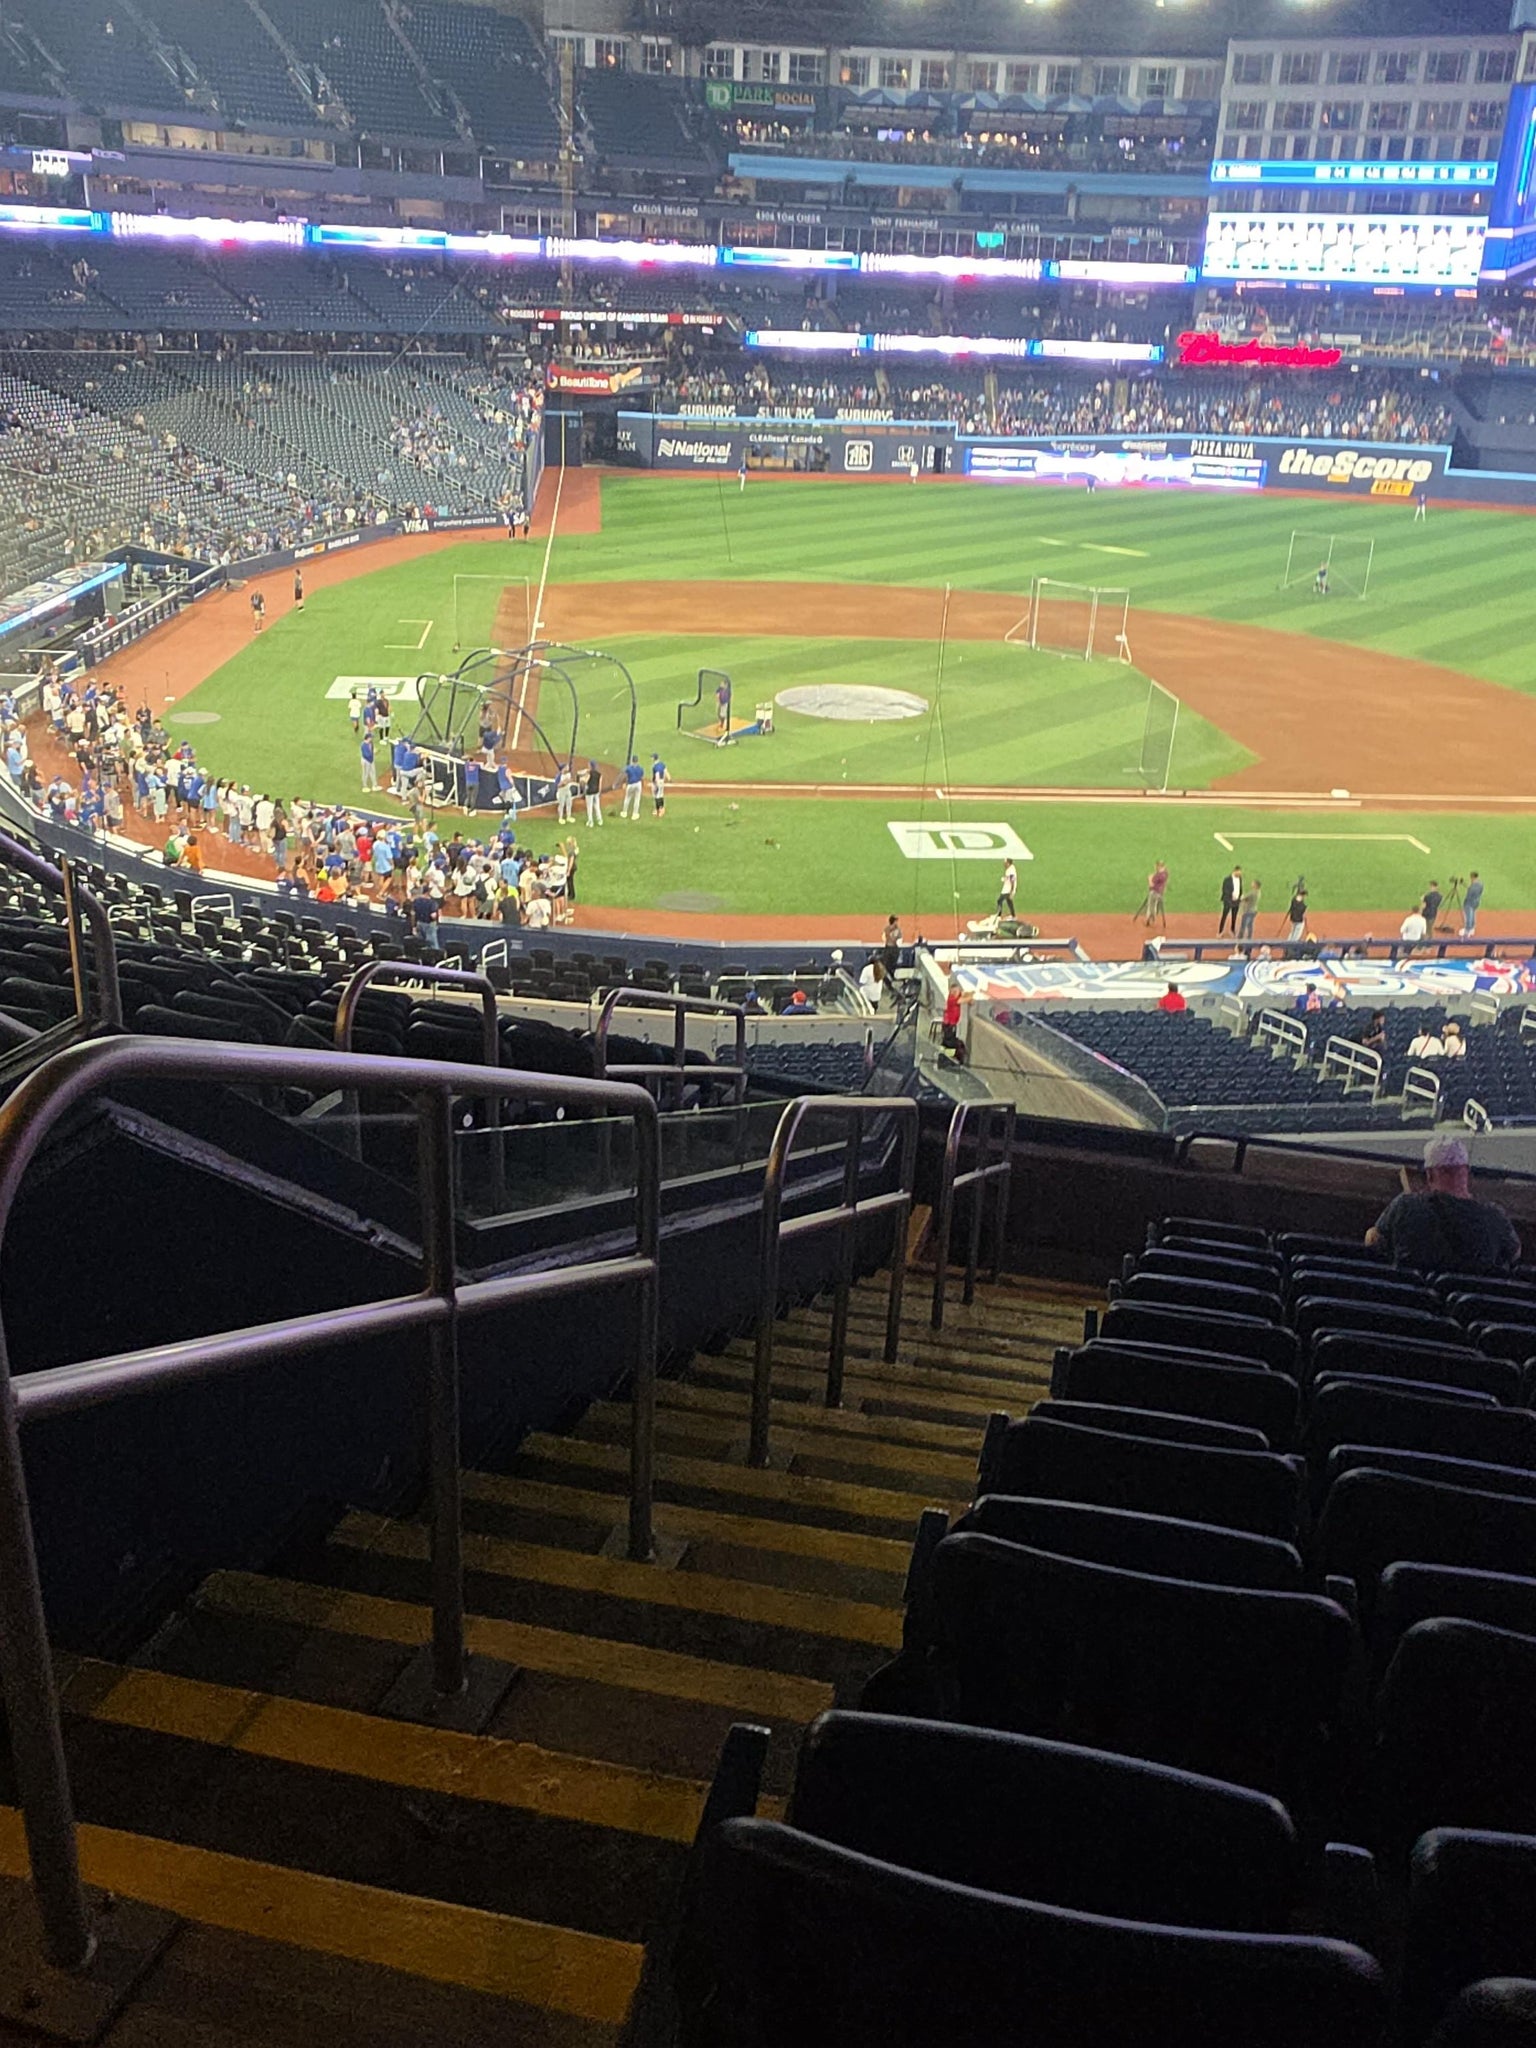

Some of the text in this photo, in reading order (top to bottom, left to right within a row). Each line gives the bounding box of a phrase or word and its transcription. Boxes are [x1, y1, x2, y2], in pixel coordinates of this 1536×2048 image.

[712, 86, 730, 105] TD
[734, 86, 773, 100] PARK
[675, 440, 731, 457] National
[1191, 440, 1254, 458] PIZZA NOVA
[1279, 448, 1432, 482] theScore
[403, 519, 429, 533] VISA
[906, 830, 1007, 850] TD
